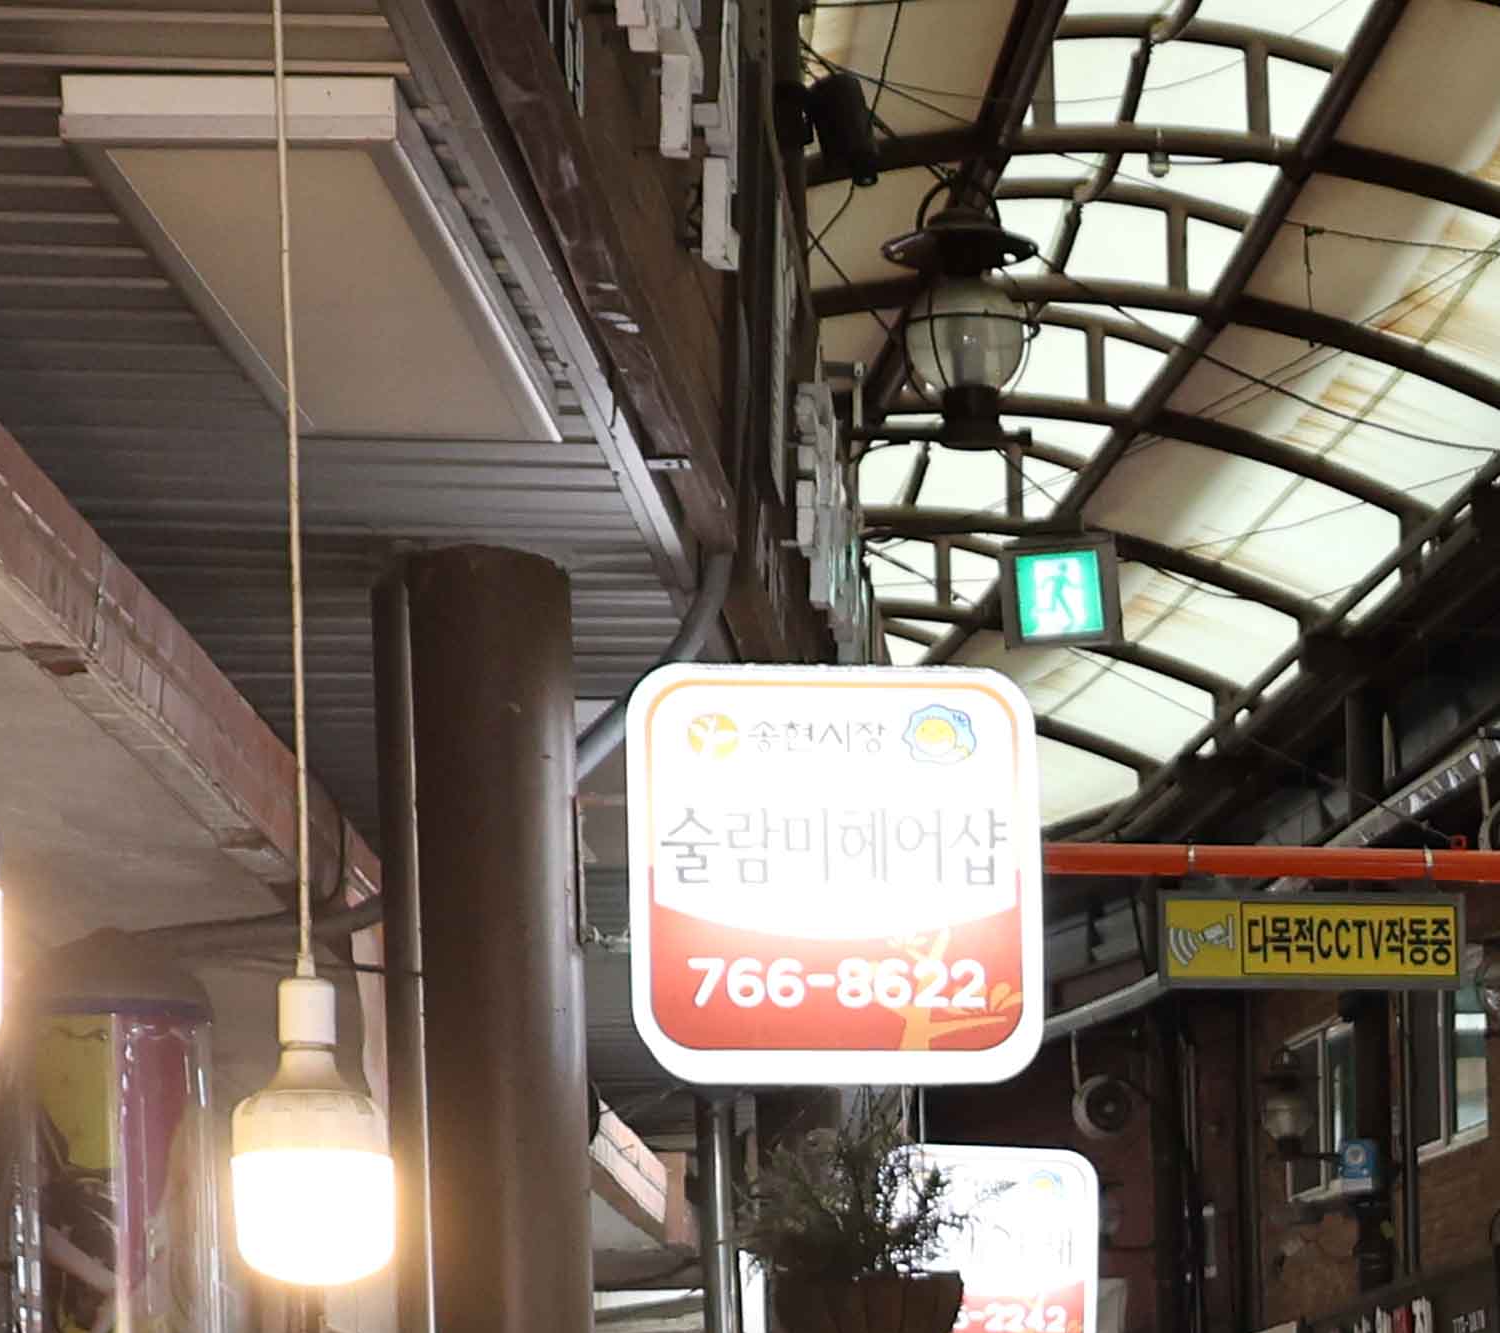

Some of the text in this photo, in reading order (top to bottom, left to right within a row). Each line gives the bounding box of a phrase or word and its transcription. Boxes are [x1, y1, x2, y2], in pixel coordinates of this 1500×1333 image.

[746, 715, 888, 758] 송현시장
[1246, 914, 1453, 970] 다목적CCTV작동중
[687, 955, 986, 1010] 766-8622
